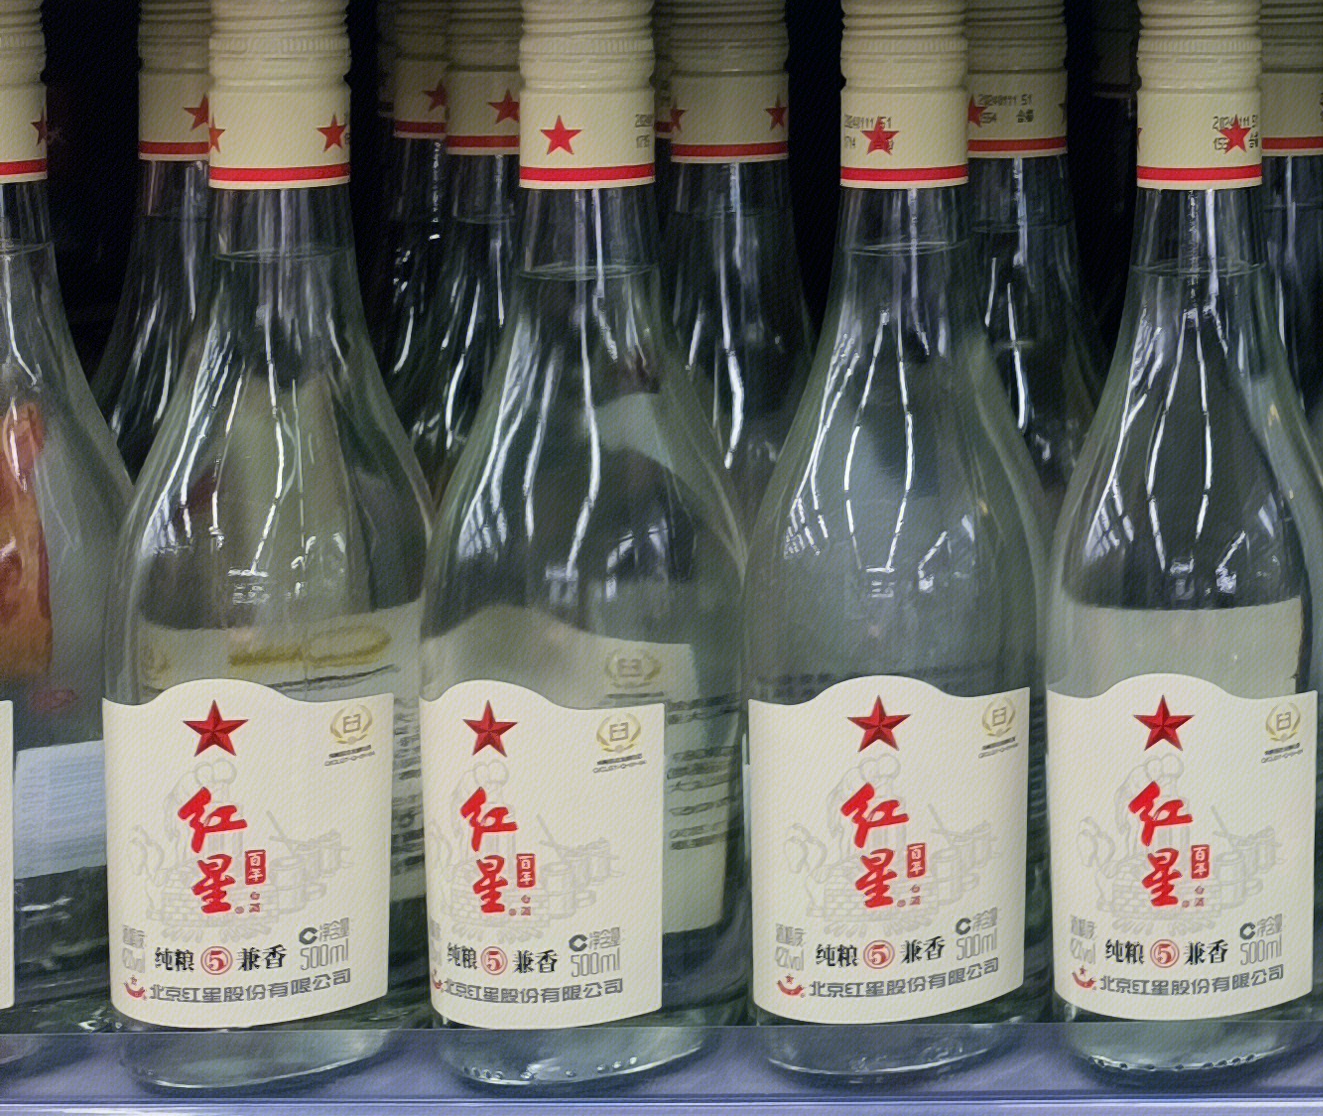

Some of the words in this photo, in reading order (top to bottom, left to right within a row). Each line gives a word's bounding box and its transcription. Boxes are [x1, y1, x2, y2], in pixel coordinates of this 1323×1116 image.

[177, 786, 248, 914] 红星
[460, 786, 519, 914] 红星
[840, 782, 910, 908] 红星
[1128, 780, 1194, 908] 红星
[154, 946, 195, 972] 纯粮
[237, 945, 287, 971] 兼香
[300, 939, 349, 971] 500ml
[447, 943, 478, 970] 纯粮
[513, 949, 558, 974] 兼香
[570, 951, 621, 978] 500ml
[815, 944, 858, 967] 纯粮
[901, 936, 945, 963] 兼香
[1105, 939, 1145, 964] 纯粮
[1184, 939, 1229, 964] 兼香
[1240, 936, 1282, 965] 500ml
[149, 968, 351, 1003] 北京红星股份有限公司
[445, 979, 623, 1004] 北京红星股份有限公司
[810, 957, 999, 998] 北京红星股份有限公司
[1099, 964, 1284, 995] 北京红星股份有限公司
